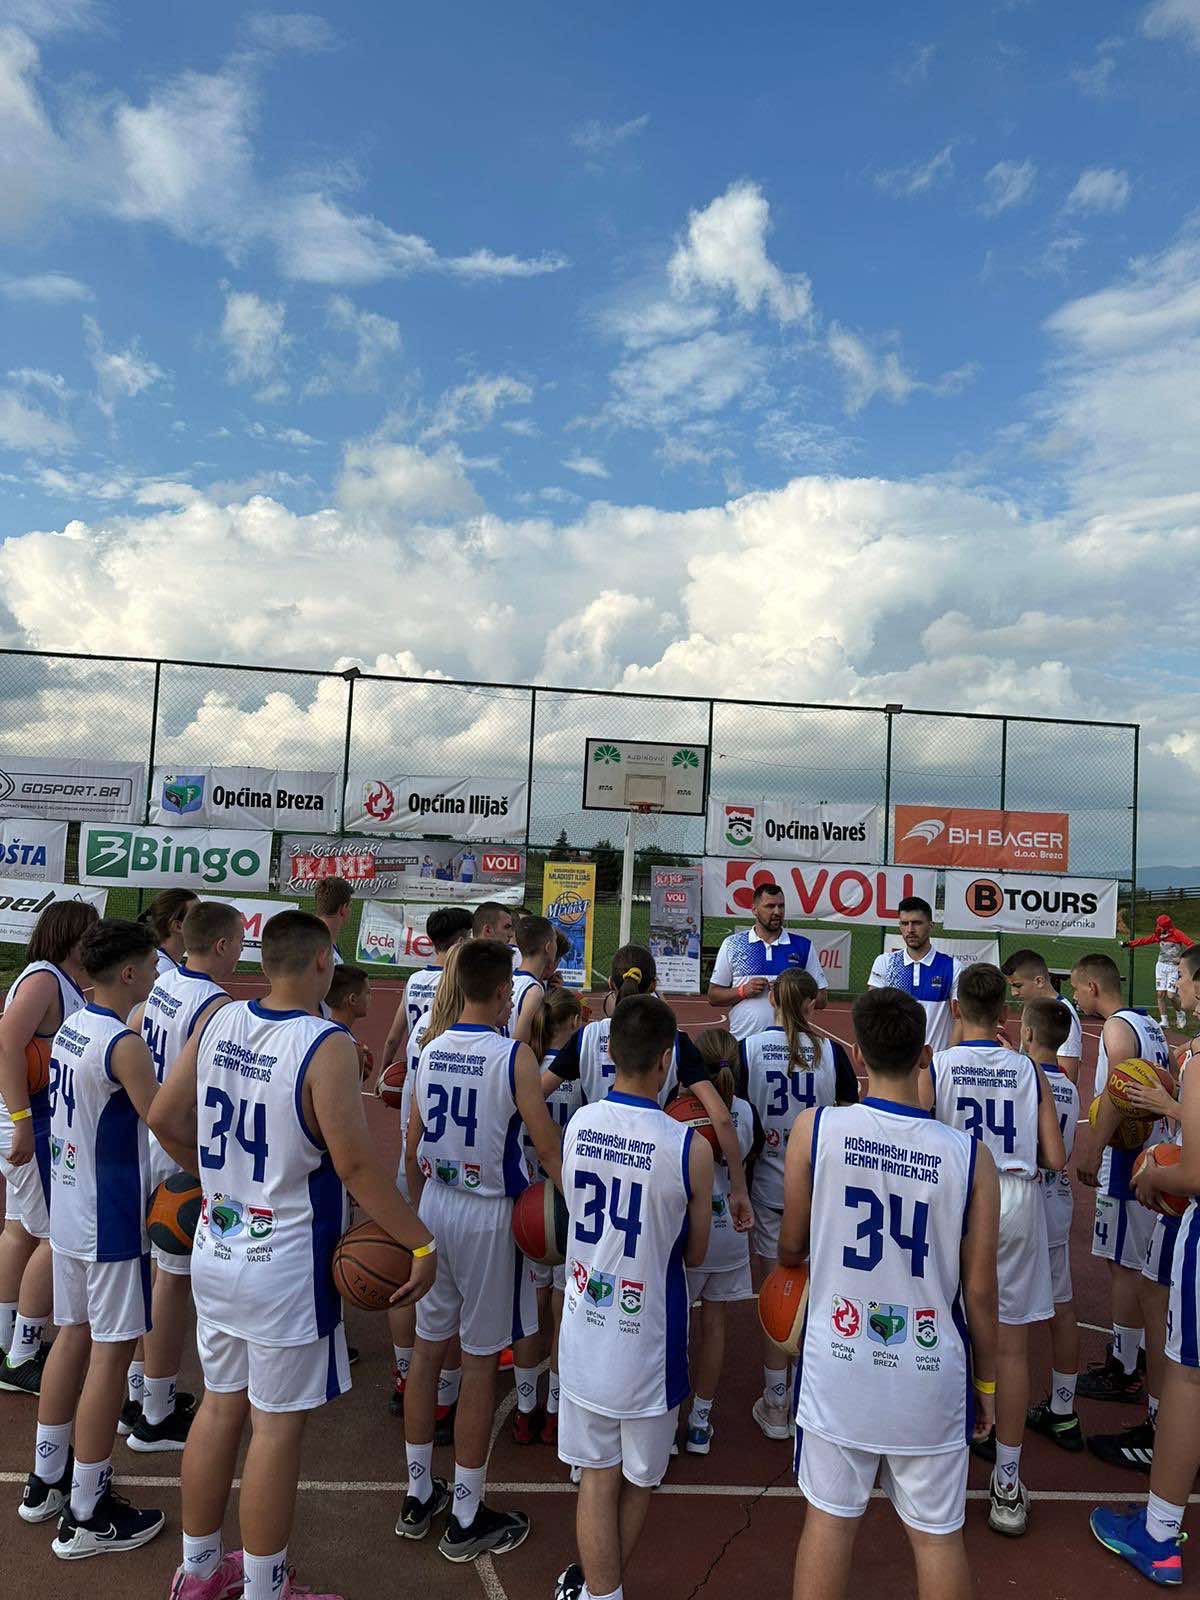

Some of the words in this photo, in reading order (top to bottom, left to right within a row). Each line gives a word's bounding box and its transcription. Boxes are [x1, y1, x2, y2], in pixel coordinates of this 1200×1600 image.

[21, 782, 121, 798] GOSPORT.BA
[212, 785, 272, 810] Općina
[276, 788, 324, 811] Breza
[408, 792, 465, 816] Općina
[469, 795, 509, 818] Ilijaš
[765, 818, 819, 842] Općina
[821, 821, 866, 842] Vareš
[948, 827, 982, 846] BH
[987, 830, 1064, 850] BAGER
[131, 835, 261, 884] Bingo
[306, 842, 384, 859] Košarkaški
[1014, 850, 1039, 858] d.o.o.
[1039, 850, 1063, 860] Breza
[295, 856, 374, 879] KAMP
[485, 857, 518, 870] VOLI
[1003, 888, 1098, 915] TOURS
[1024, 918, 1060, 930] prijevoz
[1061, 919, 1096, 932] putnika
[951, 1064, 996, 1077] KOŠARKAŠKI
[995, 1068, 1018, 1079] KAMP
[953, 1075, 977, 1087] KENAN
[976, 1077, 1018, 1089] KAMENJAŠ
[765, 1070, 817, 1117] 34
[423, 1082, 478, 1148] 34
[956, 1096, 1017, 1154] 34
[200, 1085, 269, 1184] 34
[577, 1128, 627, 1151] KOŠARKAŠKI
[627, 1138, 656, 1156] KAMP
[575, 1143, 602, 1160] KENAN
[603, 1147, 652, 1171] KAMENJAŠ
[844, 1136, 909, 1162] KOŠARKAŠKI
[909, 1150, 942, 1169] KAMP
[844, 1151, 879, 1170] KENAN
[880, 1157, 940, 1184] KAMENJAŠ
[574, 1169, 643, 1259] 34
[842, 1185, 930, 1279] 34
[246, 1246, 273, 1255] OPĆINA
[246, 1253, 272, 1263] VAREŠ
[830, 1341, 856, 1354] OPĆINA
[832, 1350, 854, 1362] ILIJAŠ
[872, 1350, 900, 1361] OPĆINA
[915, 1354, 941, 1364] OPĆINA
[873, 1358, 898, 1369] BREZA
[916, 1363, 940, 1373] VAREŠ
